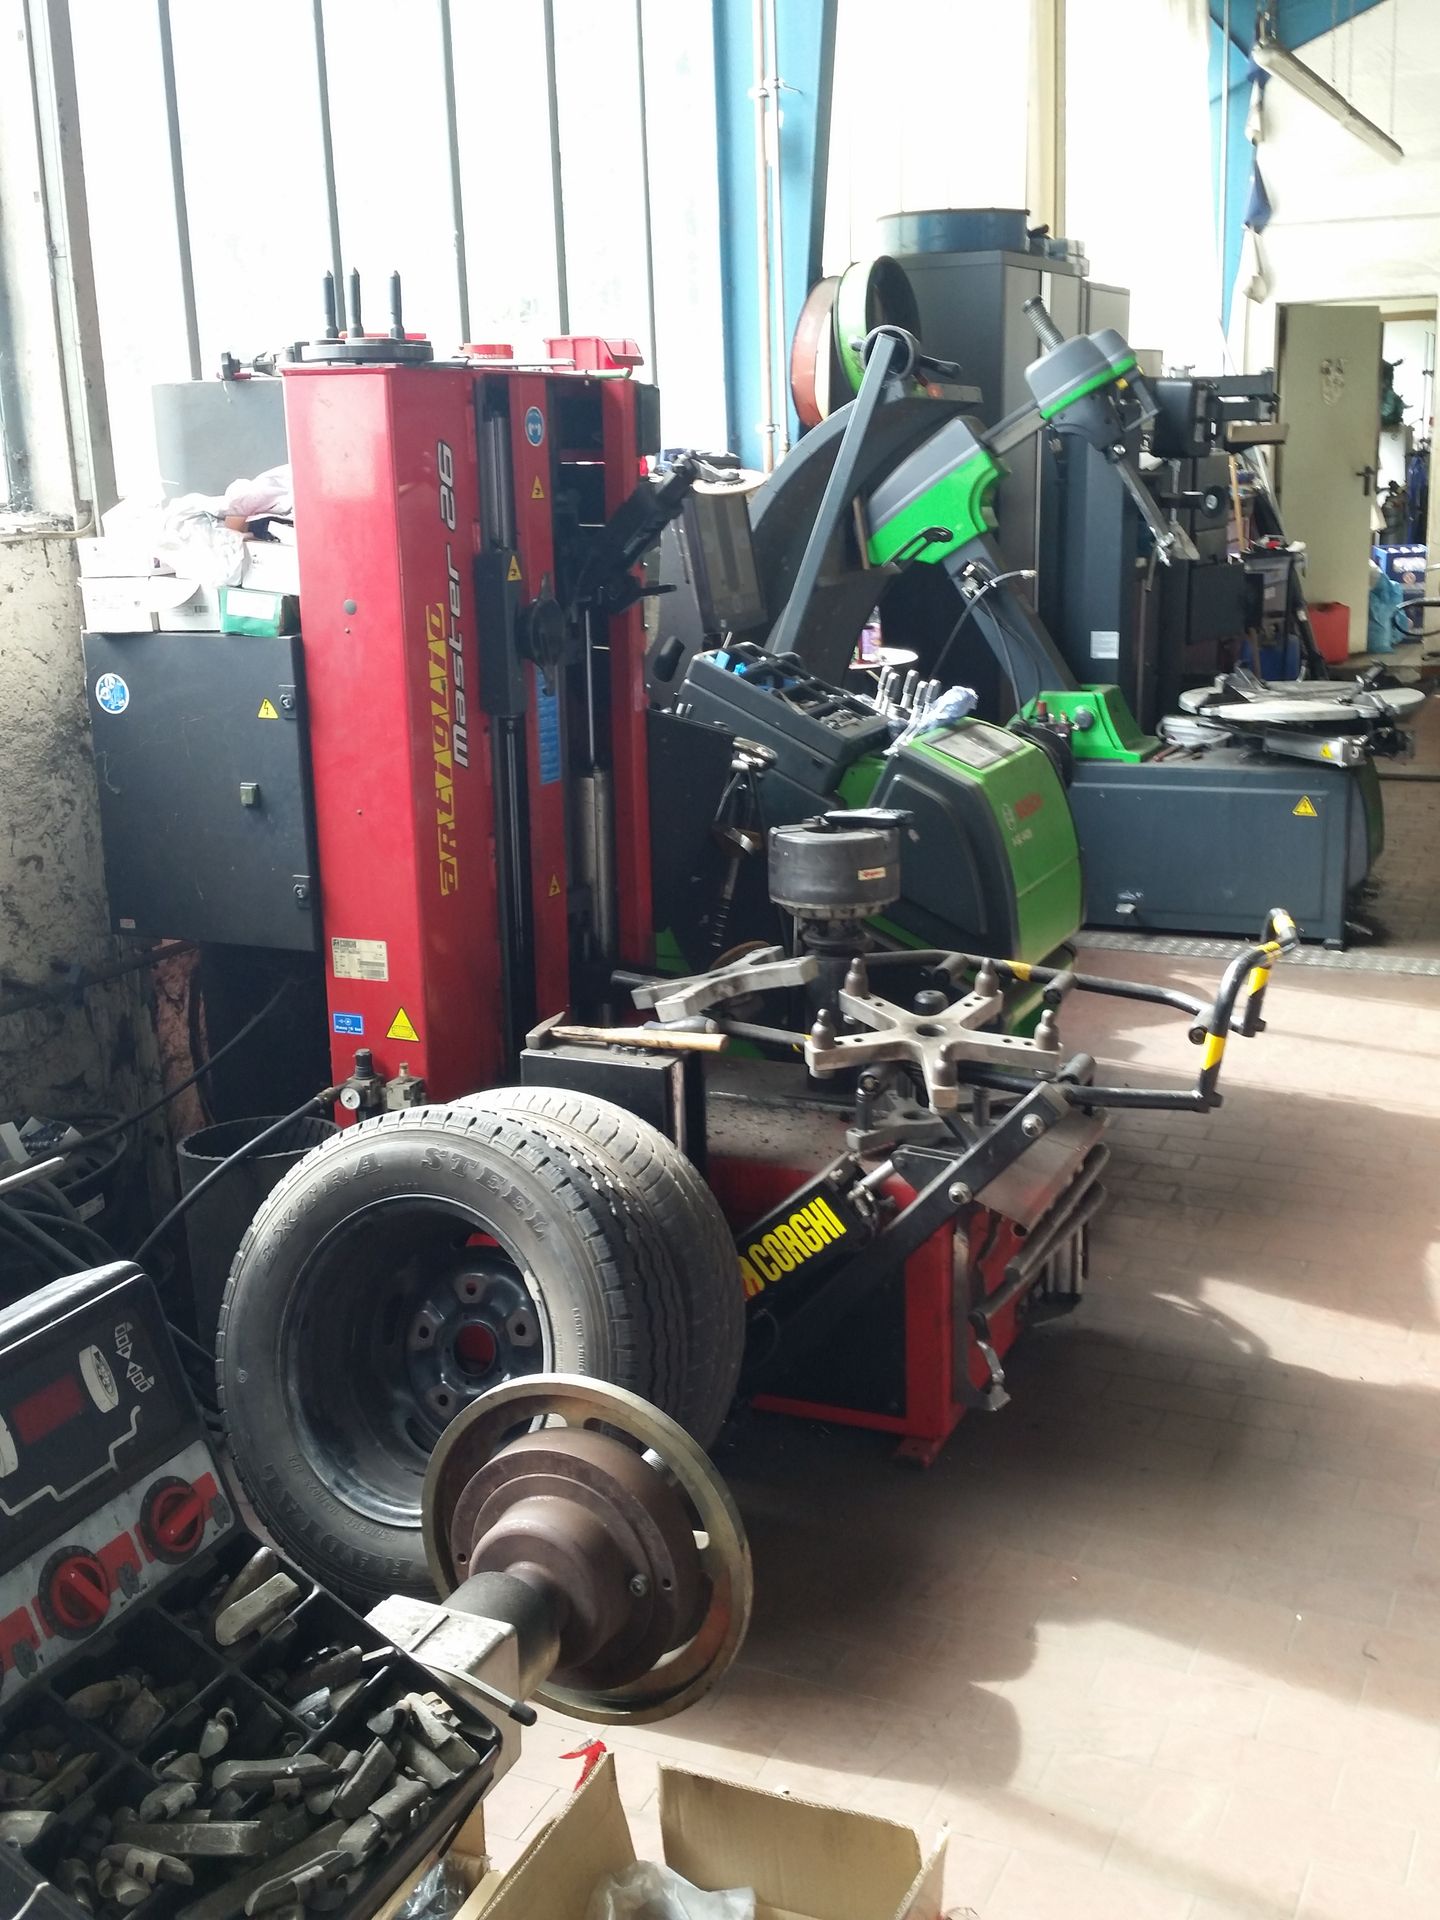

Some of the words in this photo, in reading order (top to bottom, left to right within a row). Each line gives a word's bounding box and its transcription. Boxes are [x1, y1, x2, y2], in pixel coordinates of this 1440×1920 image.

[437, 439, 456, 531] 26
[252, 1152, 383, 1278] EXTRA
[420, 1146, 549, 1243] STEEL
[747, 1196, 847, 1282] CORGHI
